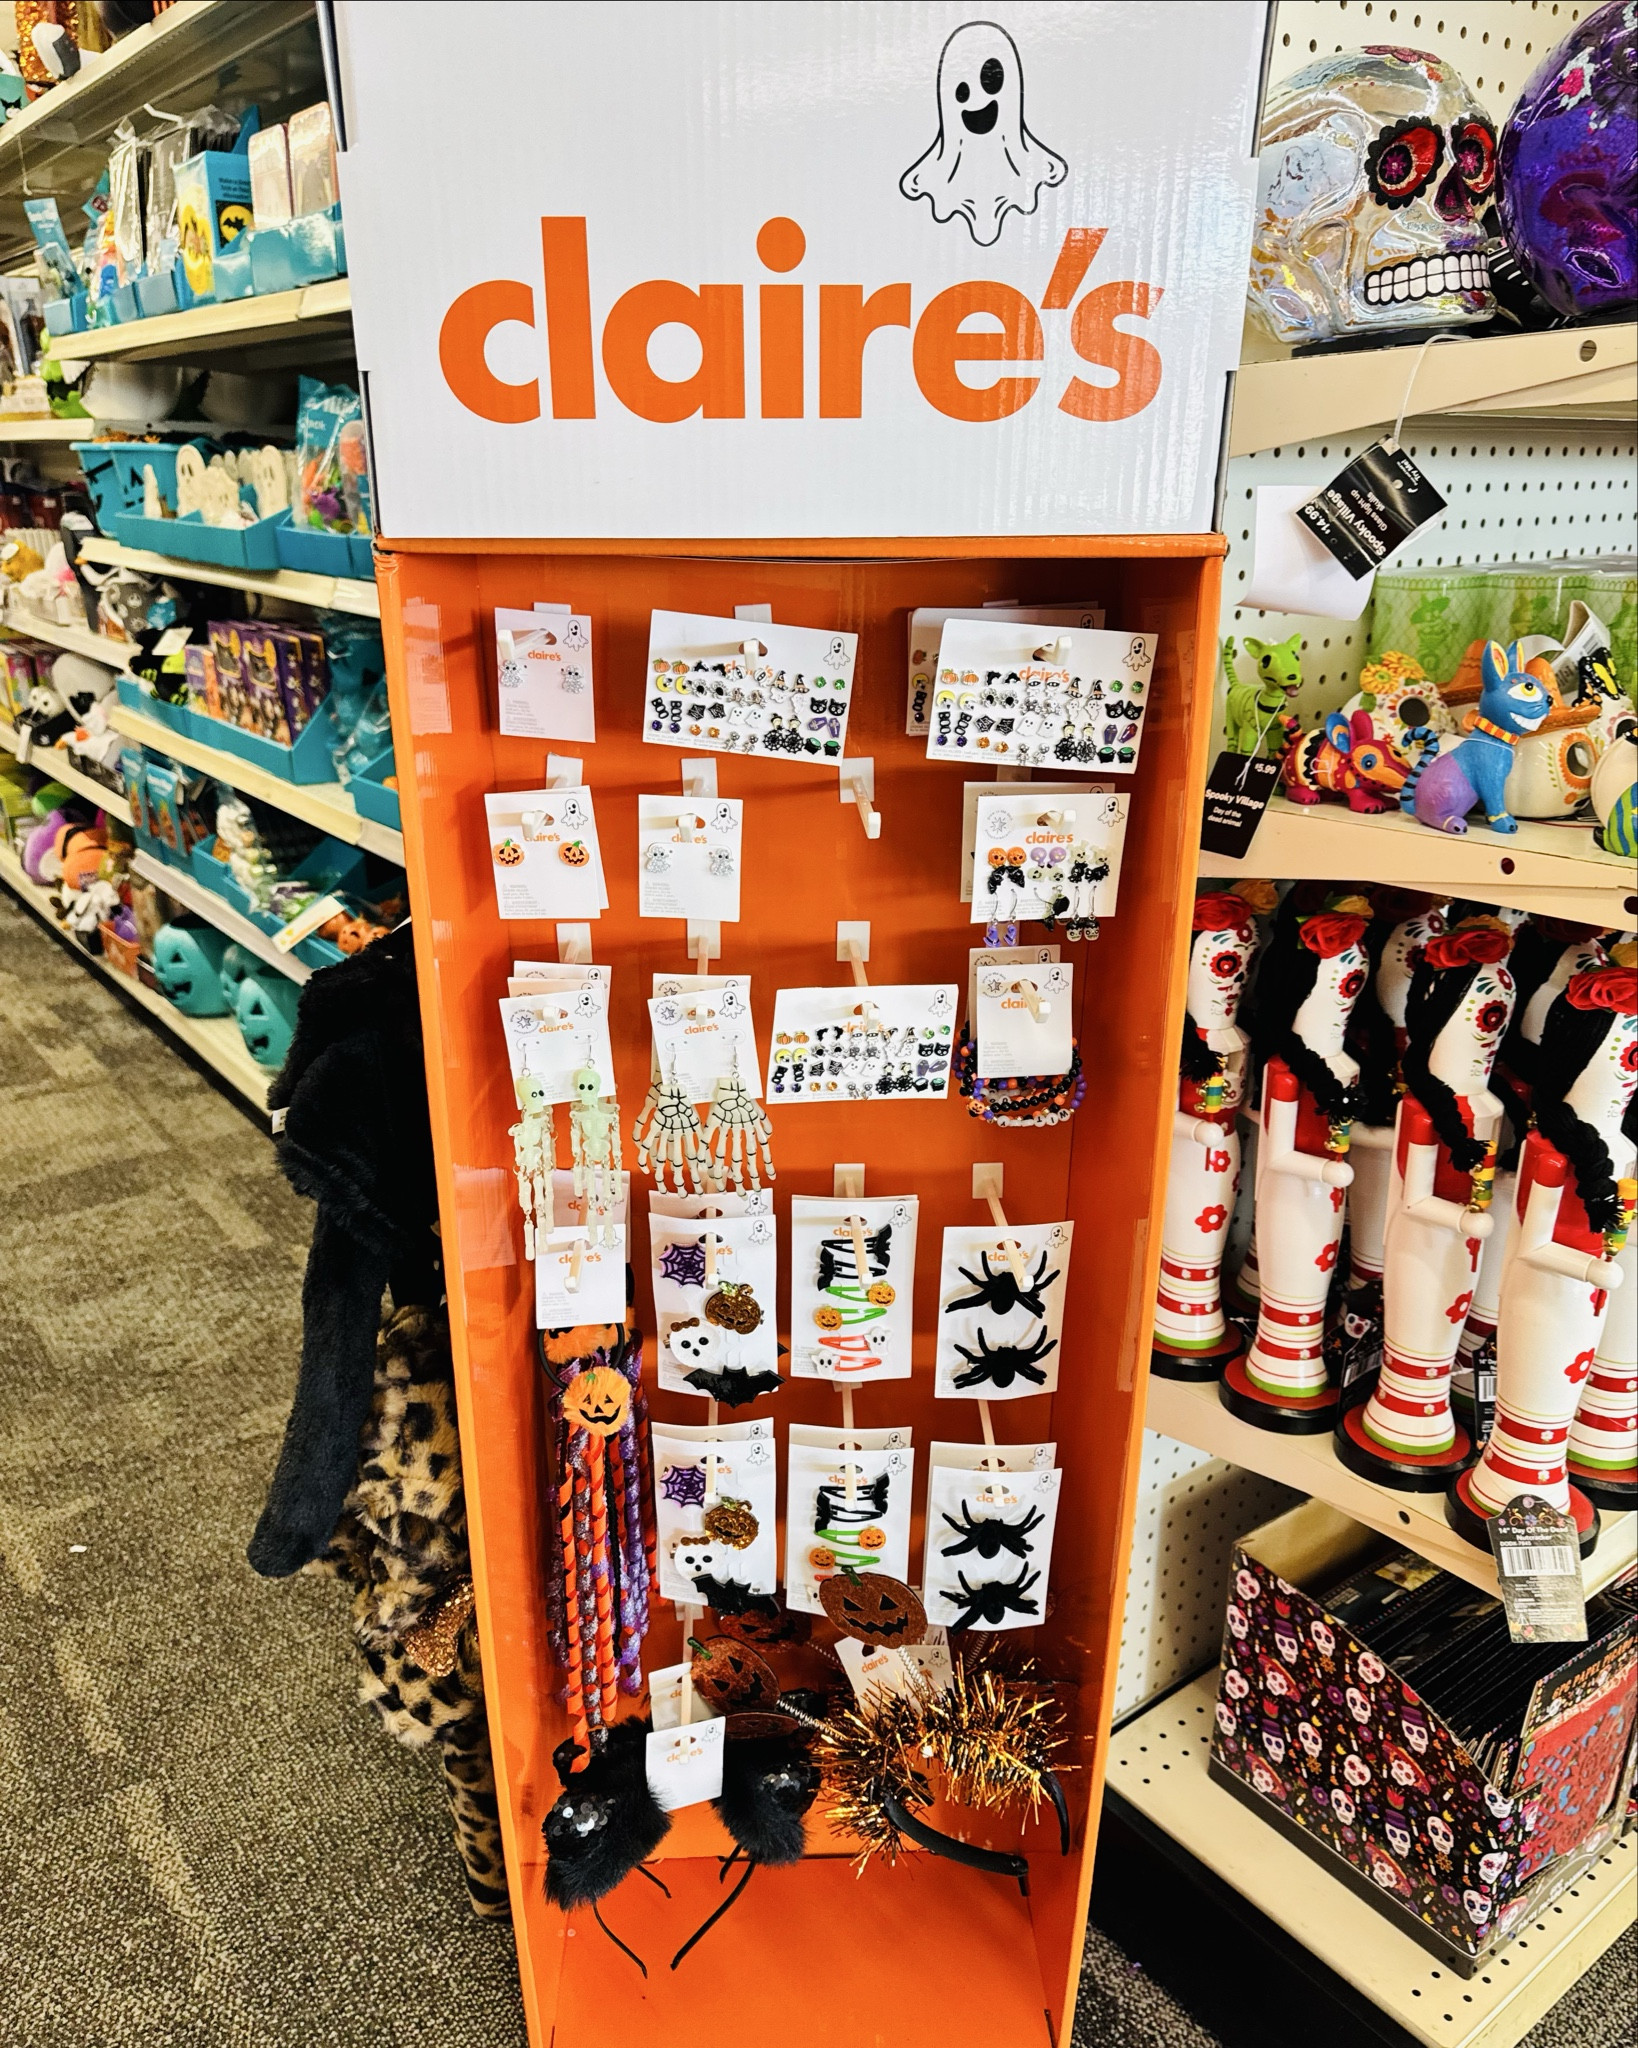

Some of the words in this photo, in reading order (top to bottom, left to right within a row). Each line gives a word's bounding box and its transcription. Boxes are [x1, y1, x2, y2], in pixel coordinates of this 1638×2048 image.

[439, 216, 1165, 424] claire's
[1350, 489, 1361, 501] up
[1366, 491, 1386, 512] skulls
[1326, 489, 1356, 523] Village
[1357, 501, 1373, 517] light
[1304, 505, 1331, 534] $14.99
[1370, 511, 1388, 532] Glass
[1354, 518, 1386, 557] Spooky
[527, 650, 582, 661] claire's
[1254, 763, 1277, 775] $5.99
[1205, 789, 1235, 804] Spooky
[1235, 794, 1265, 810] Village
[1213, 806, 1224, 815] Day
[1207, 814, 1222, 823] dead
[1222, 818, 1242, 828] animal
[538, 1022, 574, 1033] claire's
[684, 1023, 719, 1035] claire's
[558, 1253, 602, 1264] cle's
[976, 1494, 1018, 1504] clae's
[1511, 1527, 1525, 1535] Day
[861, 1653, 889, 1673] claire's
